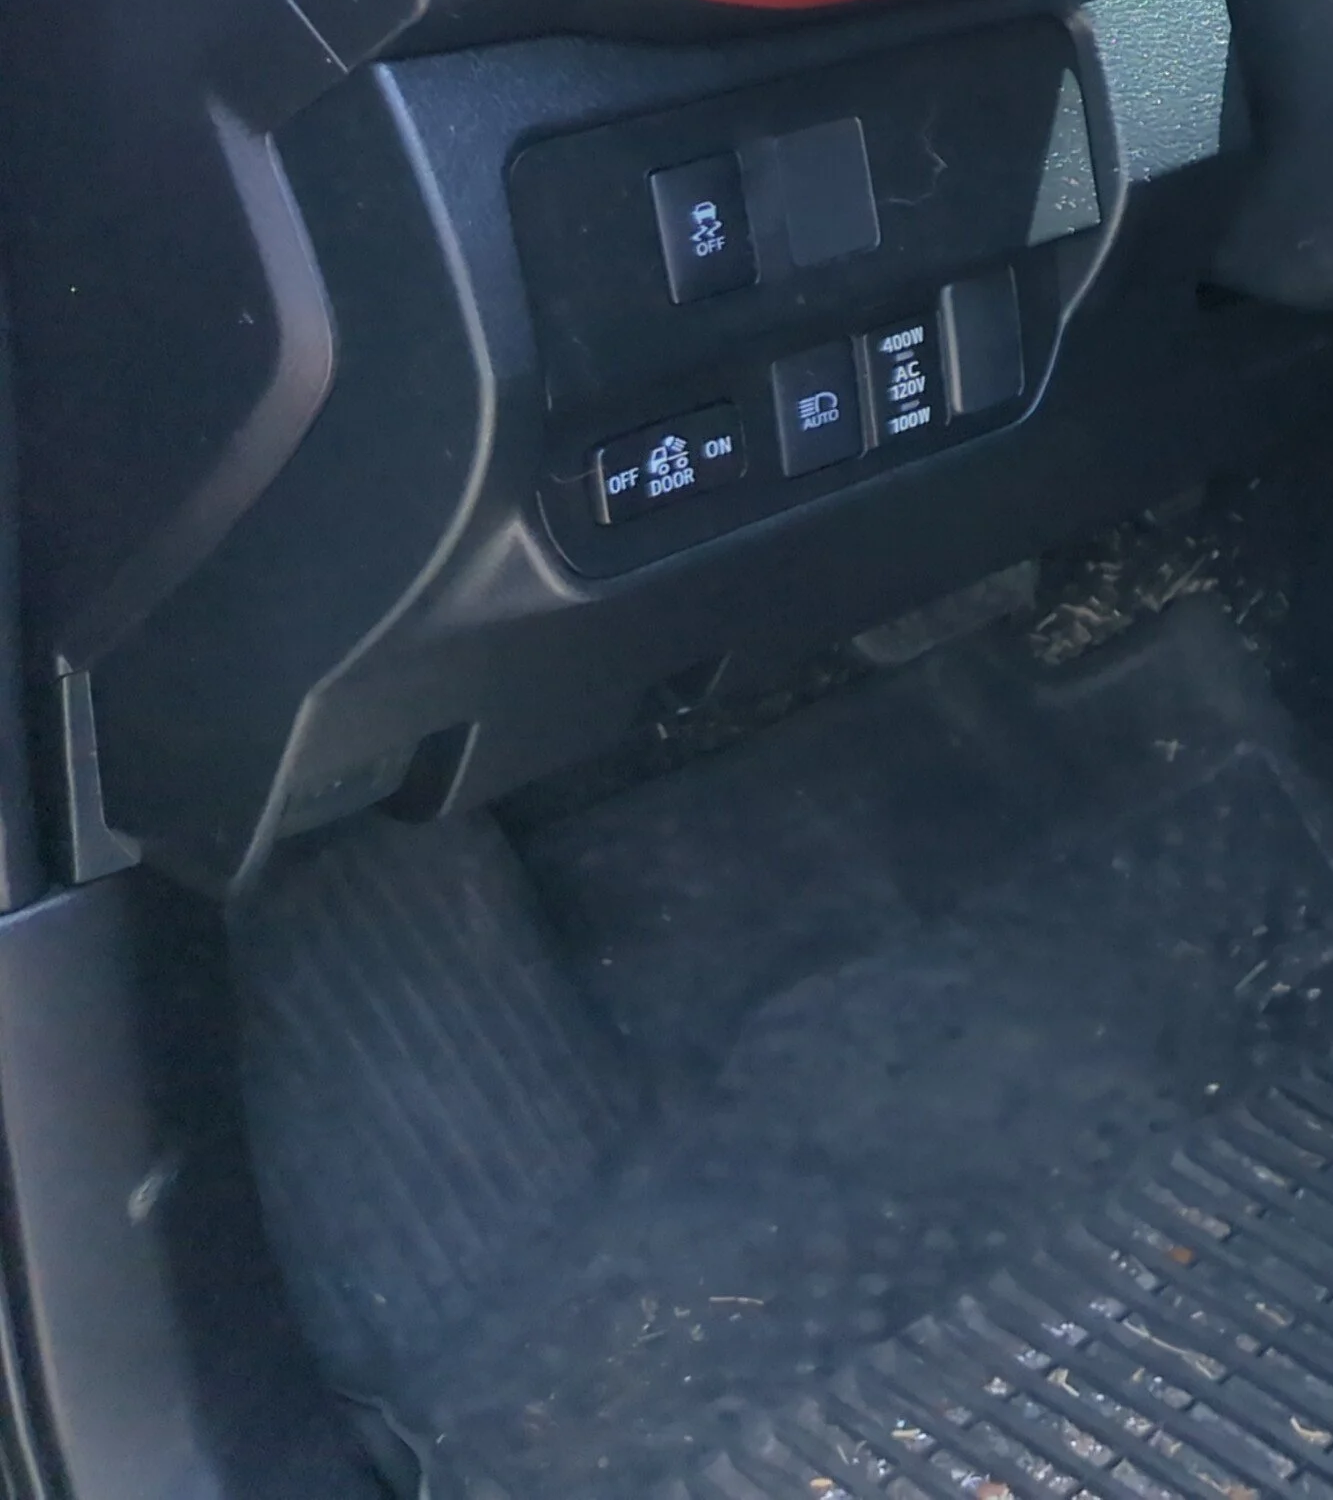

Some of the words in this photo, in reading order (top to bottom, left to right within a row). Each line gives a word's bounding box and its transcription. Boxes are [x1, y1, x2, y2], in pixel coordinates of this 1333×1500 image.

[696, 236, 726, 257] OFF
[880, 325, 924, 353] 400W
[894, 360, 921, 383] AC
[888, 376, 926, 402] 120V
[803, 408, 840, 432] AUTO
[889, 406, 931, 435] 100W
[704, 435, 732, 459] ON
[608, 466, 640, 495] OFF
[649, 466, 695, 498] DOOR
